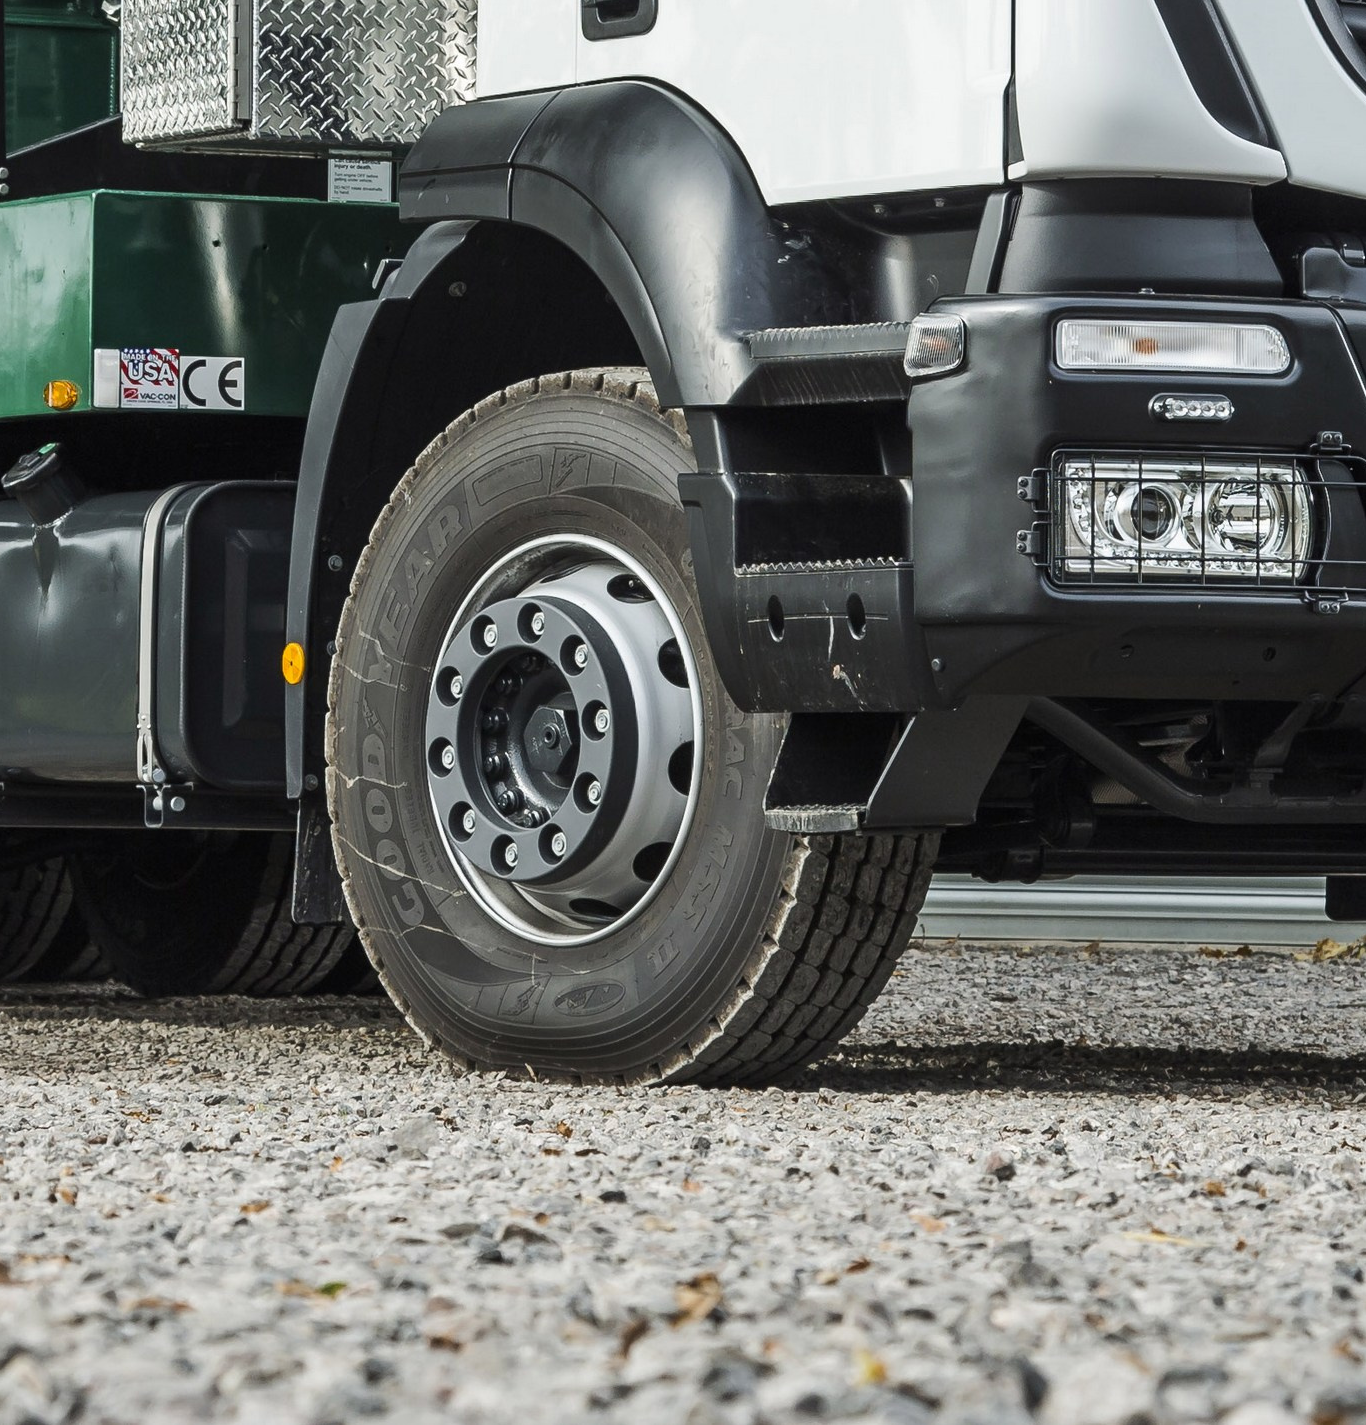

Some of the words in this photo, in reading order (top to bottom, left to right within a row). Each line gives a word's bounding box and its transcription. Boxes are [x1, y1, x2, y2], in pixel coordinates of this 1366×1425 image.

[123, 353, 146, 361] MADE
[147, 354, 158, 362] IN
[127, 361, 175, 382] USA
[182, 359, 243, 408] CE
[362, 503, 464, 926] GOODYEAR
